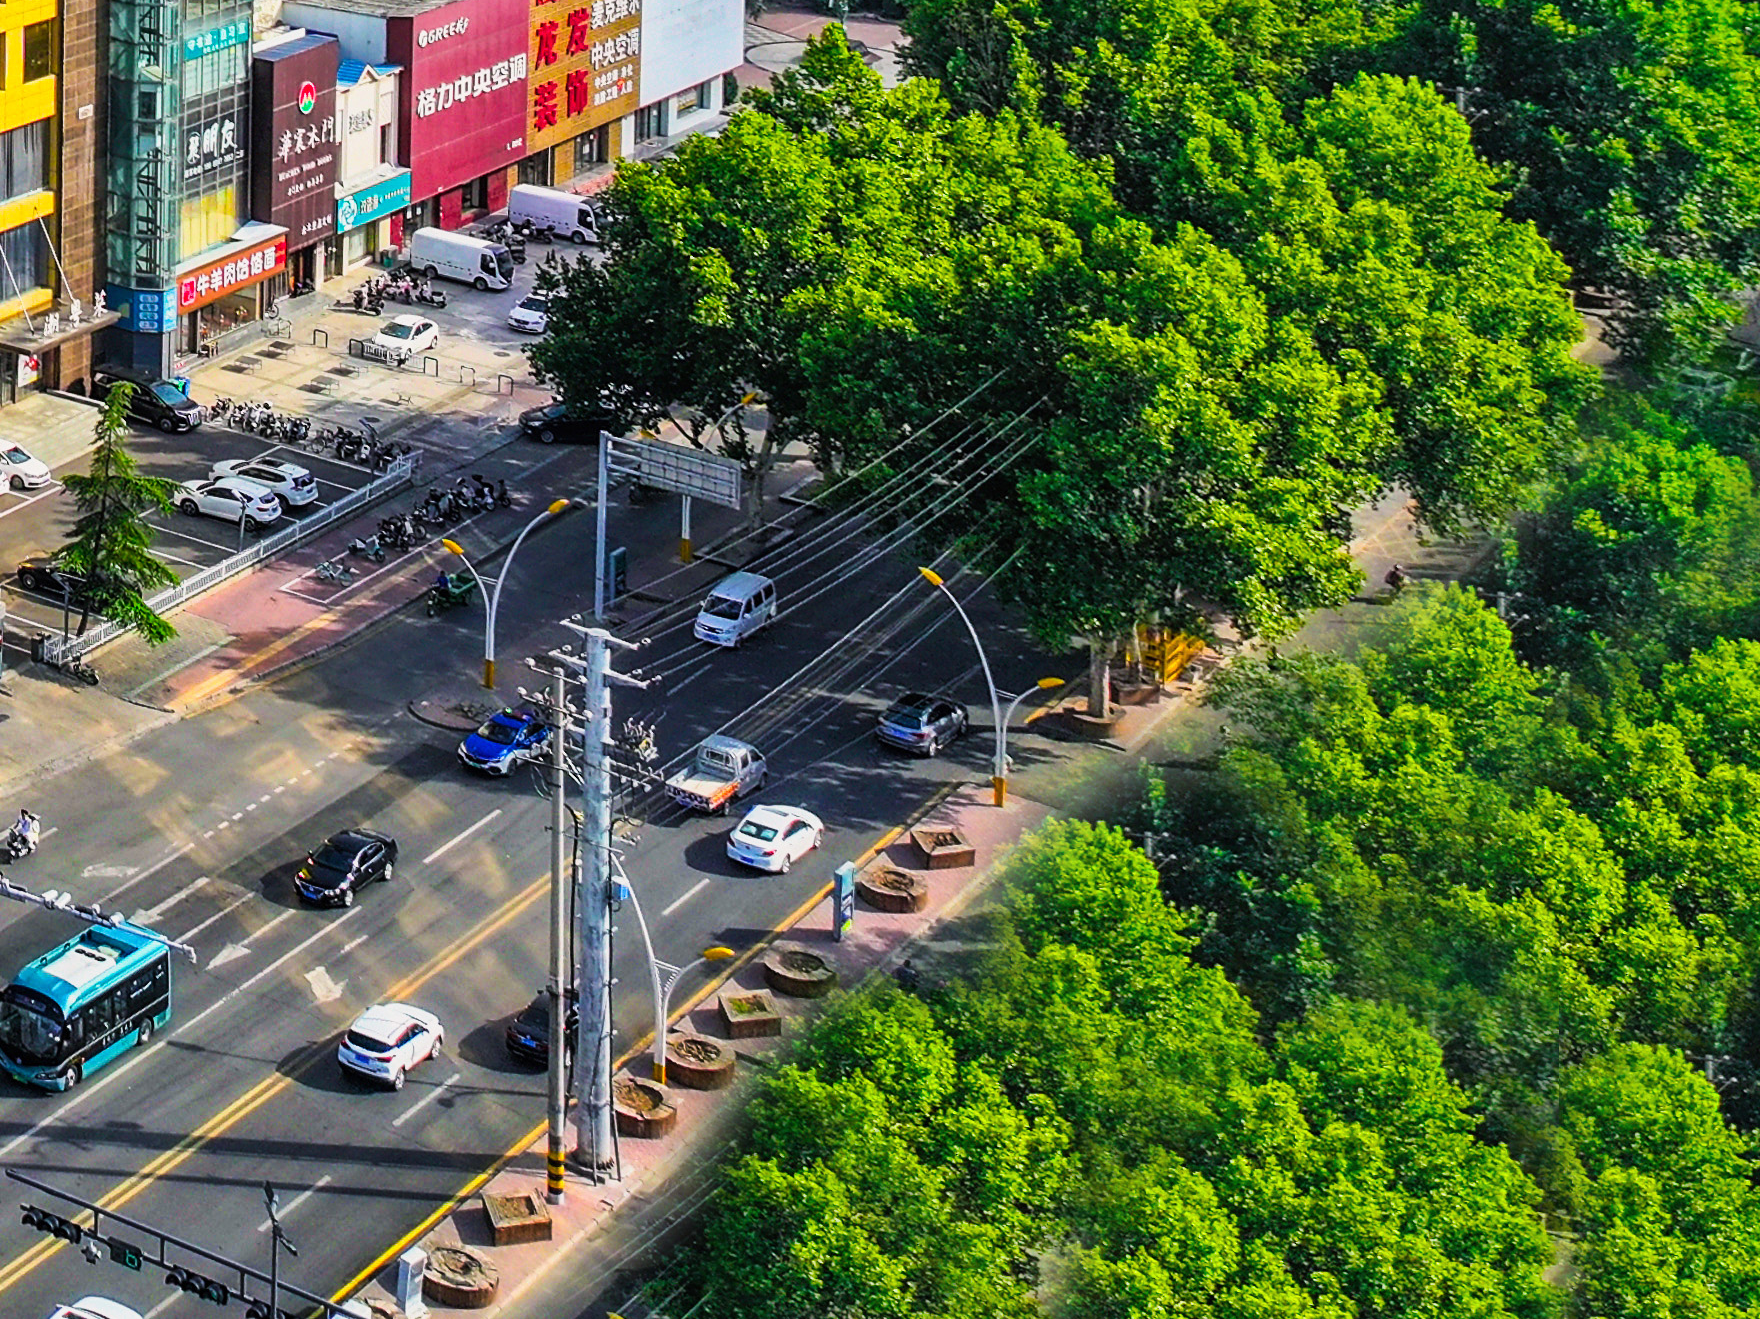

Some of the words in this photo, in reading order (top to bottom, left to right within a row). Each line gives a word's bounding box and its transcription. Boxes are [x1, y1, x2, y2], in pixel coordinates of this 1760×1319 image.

[591, 27, 640, 71] 中央空调
[417, 53, 527, 118] 格力中央空调
